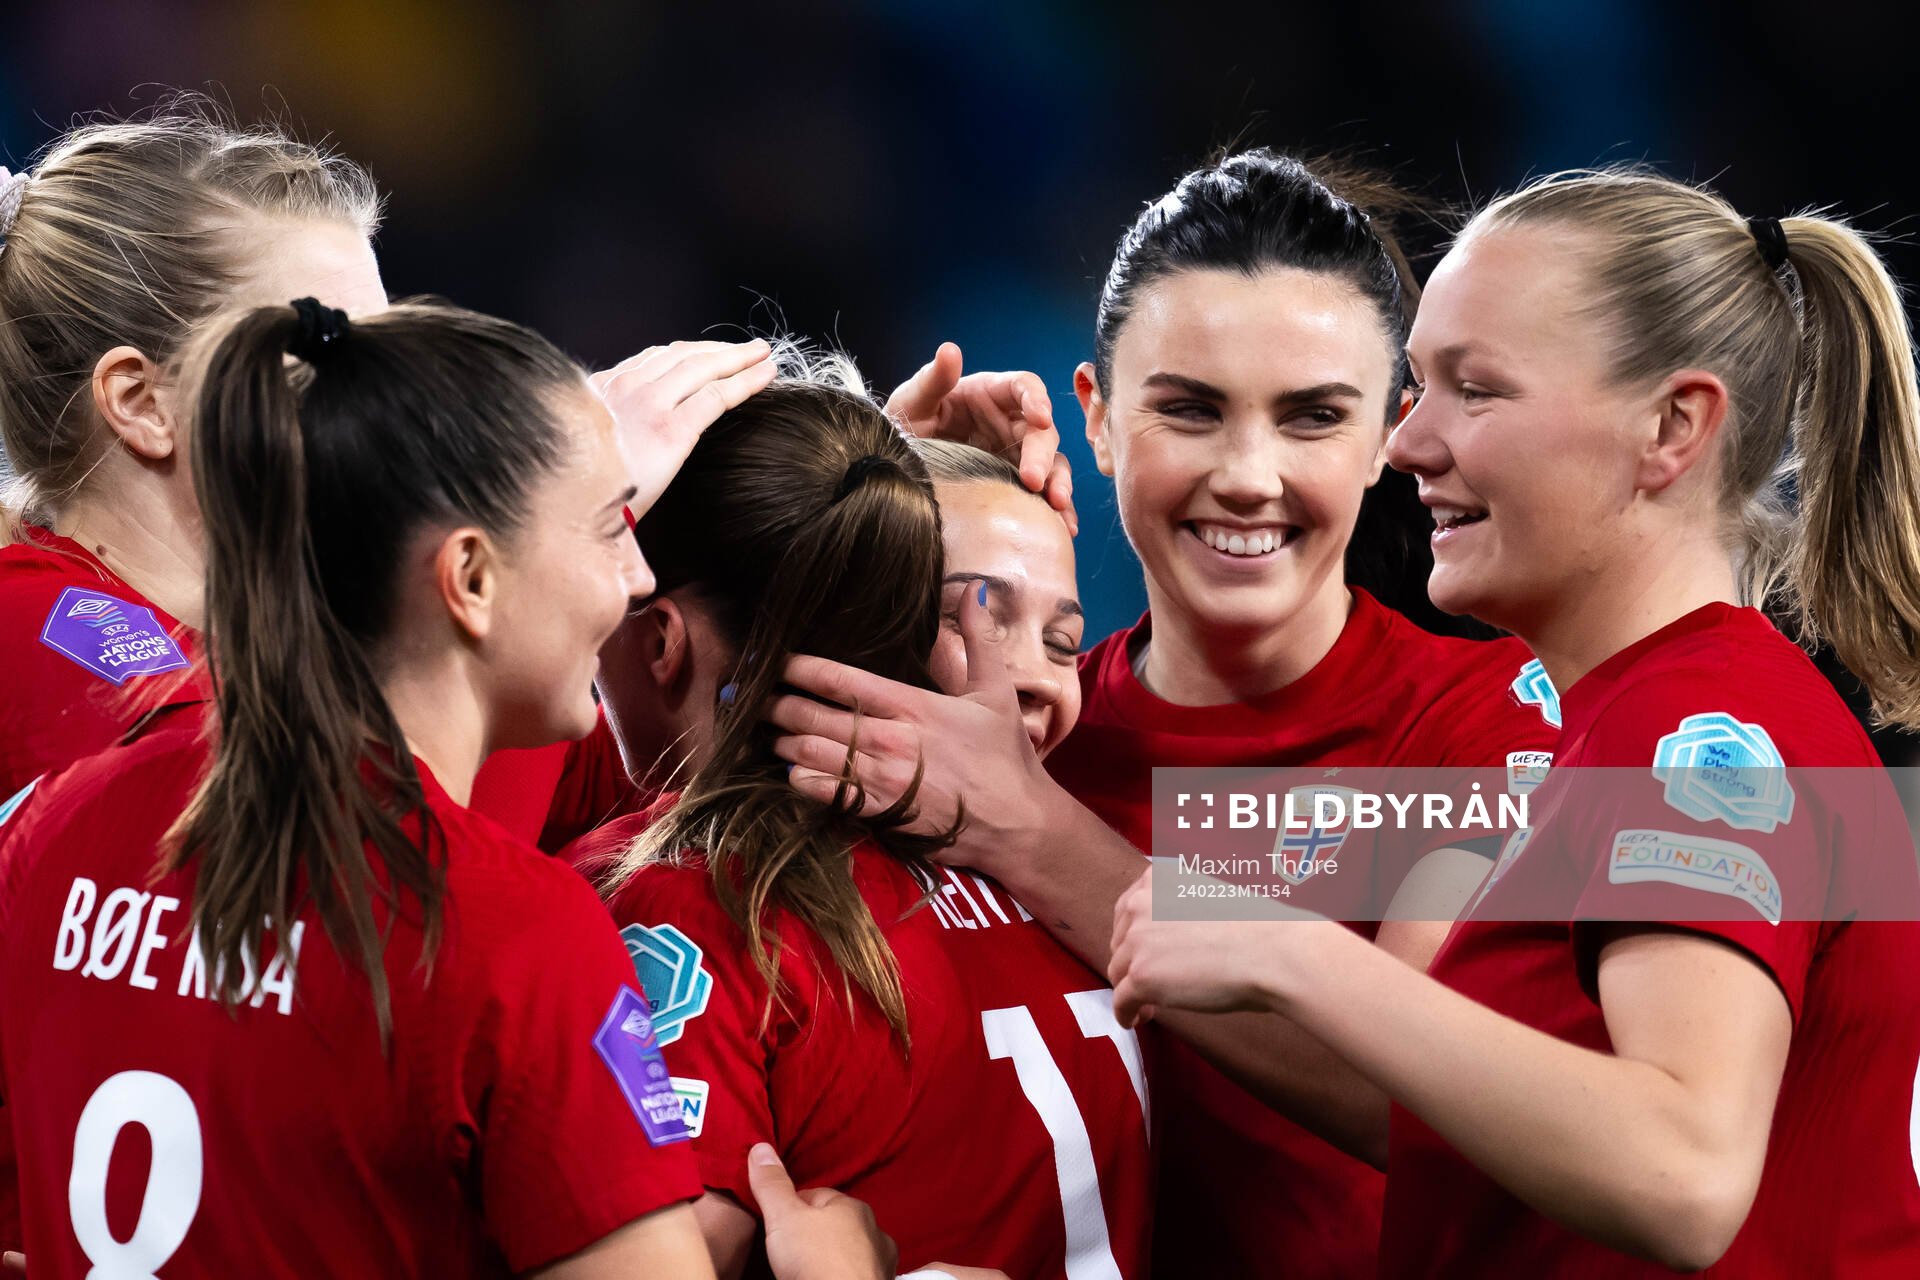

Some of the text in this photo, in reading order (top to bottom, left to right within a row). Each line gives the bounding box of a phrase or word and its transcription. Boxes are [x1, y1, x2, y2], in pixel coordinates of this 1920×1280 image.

[99, 630, 150, 647] women's
[98, 636, 166, 663] NATIONS
[109, 645, 170, 667] LEAGUE
[1513, 754, 1551, 764] UEFA
[1708, 744, 1730, 760] We
[1620, 833, 1659, 845] UEFA
[1616, 846, 1780, 907] FOUNDATION
[53, 877, 180, 991] BØE
